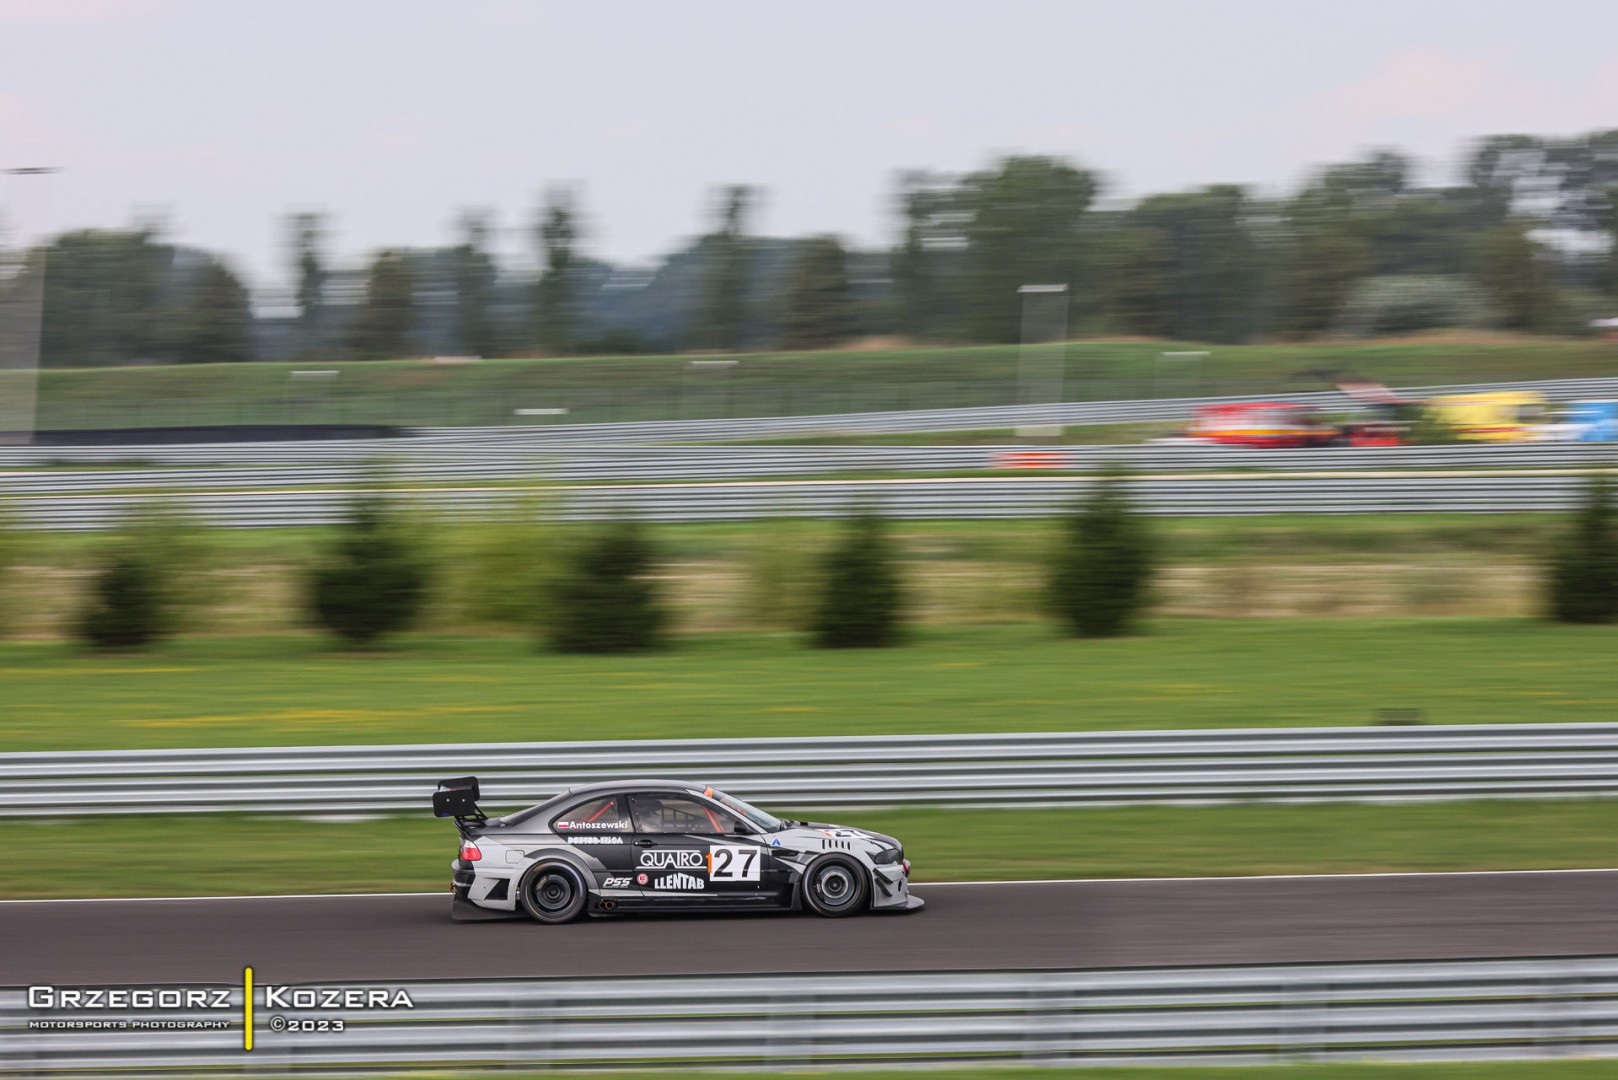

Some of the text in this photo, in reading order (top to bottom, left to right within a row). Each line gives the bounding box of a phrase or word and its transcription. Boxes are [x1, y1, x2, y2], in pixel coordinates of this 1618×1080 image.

[569, 820, 628, 829] Antoszewski
[640, 850, 703, 867] QUATRO
[603, 877, 633, 887] PSS
[654, 872, 705, 889] LLENTAB
